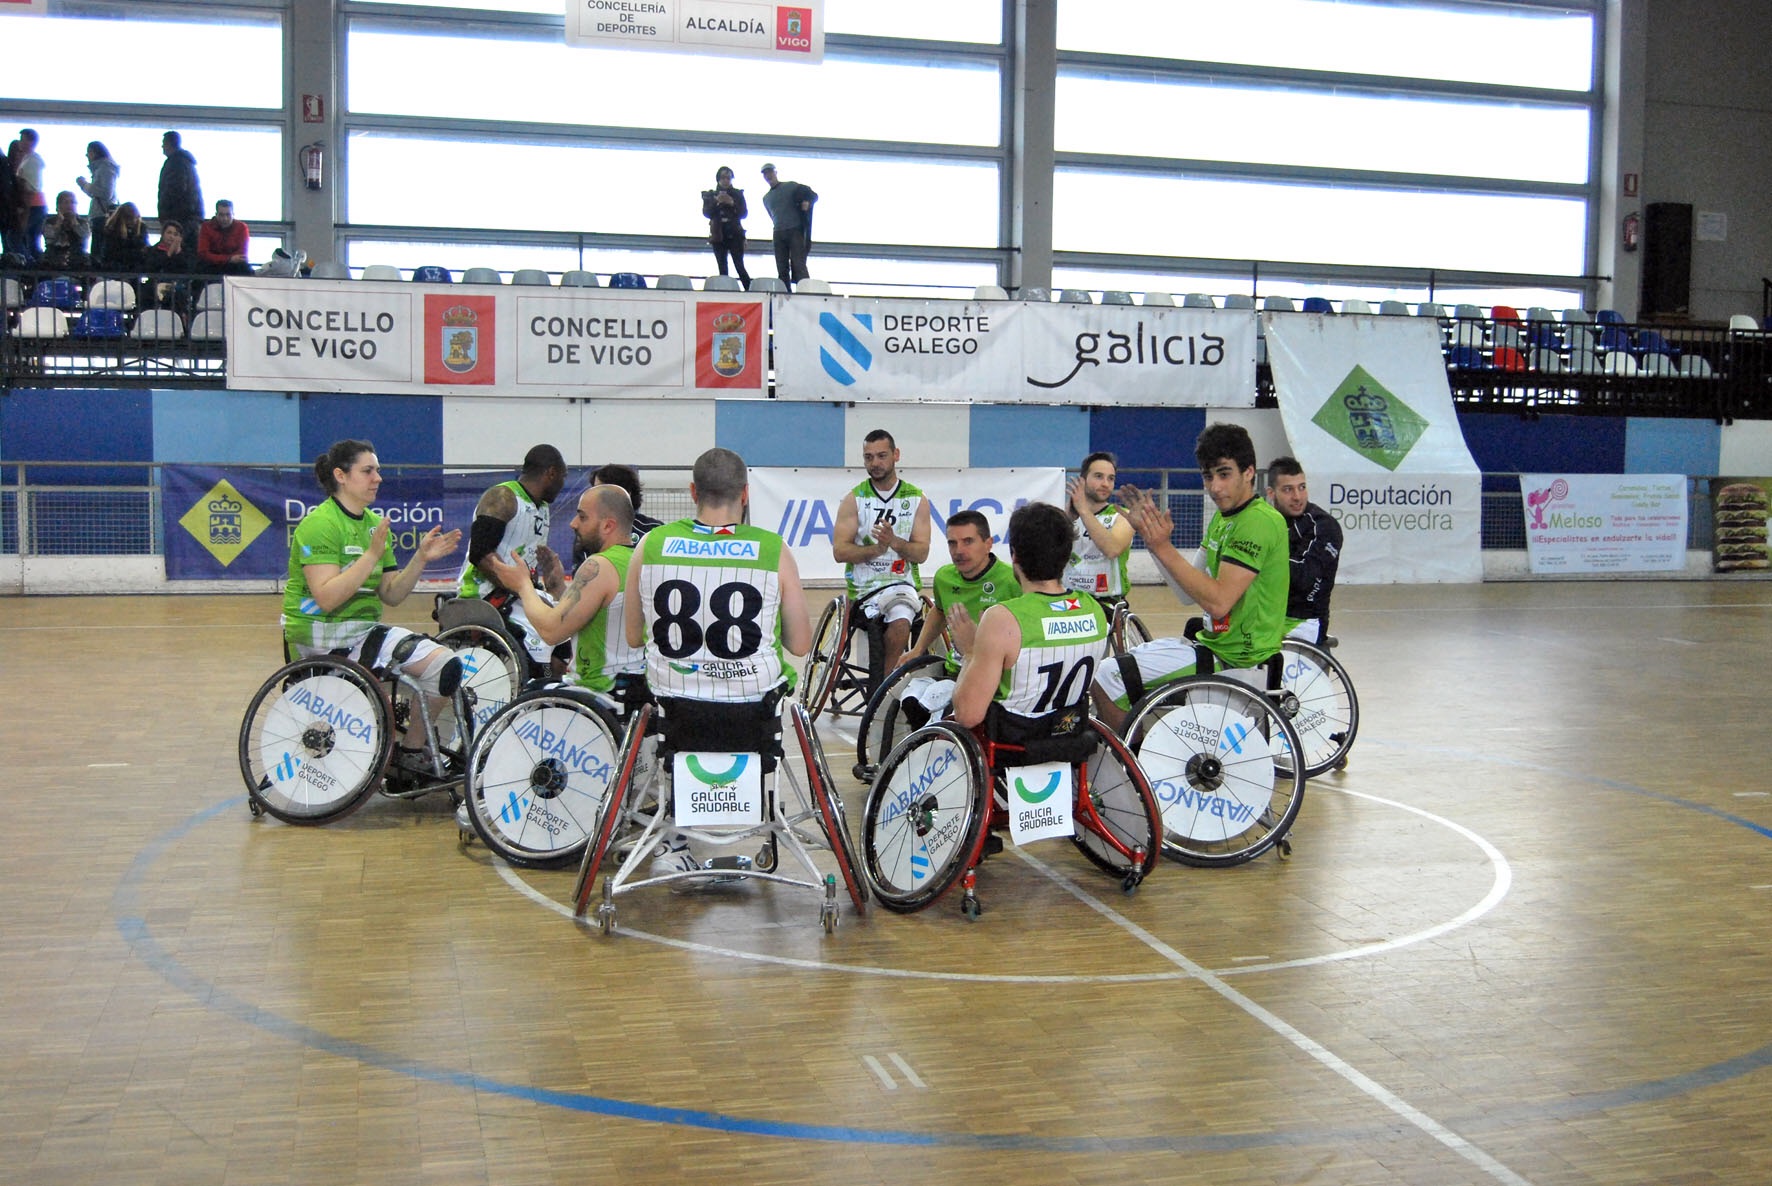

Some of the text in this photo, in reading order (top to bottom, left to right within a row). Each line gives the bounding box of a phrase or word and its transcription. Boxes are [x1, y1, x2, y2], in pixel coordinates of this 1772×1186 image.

[619, 12, 635, 23] DE
[686, 16, 766, 35] ALCALDÍA
[597, 22, 657, 36] DEPORTES
[778, 36, 809, 48] VIGO
[247, 306, 394, 333] CONCELLO
[530, 316, 668, 340] CONCELLO
[884, 314, 990, 334] DEPORTE
[266, 335, 377, 360] DE VIGO
[547, 344, 652, 366] DE VIGO
[884, 336, 978, 355] GALEGO
[1026, 321, 1225, 389] galicia
[1330, 484, 1452, 509] Deputación
[285, 499, 443, 523] Deación
[873, 508, 897, 526] 76
[1549, 512, 1602, 529] Meloso
[652, 579, 763, 660] 88
[1172, 726, 1218, 747] DEPORTE
[1180, 719, 1219, 738] GALEGO
[1299, 716, 1327, 736] GALEGO
[298, 770, 329, 792] GALEGO
[301, 762, 337, 787] DEPORTE
[691, 791, 736, 802] GALICIA
[531, 803, 570, 831] DEPORTE
[691, 802, 750, 813] SAUDABLE
[1018, 806, 1052, 822] GALICIA
[526, 812, 561, 836] GALEGO
[928, 813, 961, 848] DEPORTE
[1019, 815, 1064, 832] SAUDABLE
[929, 825, 959, 855] GALEGO
